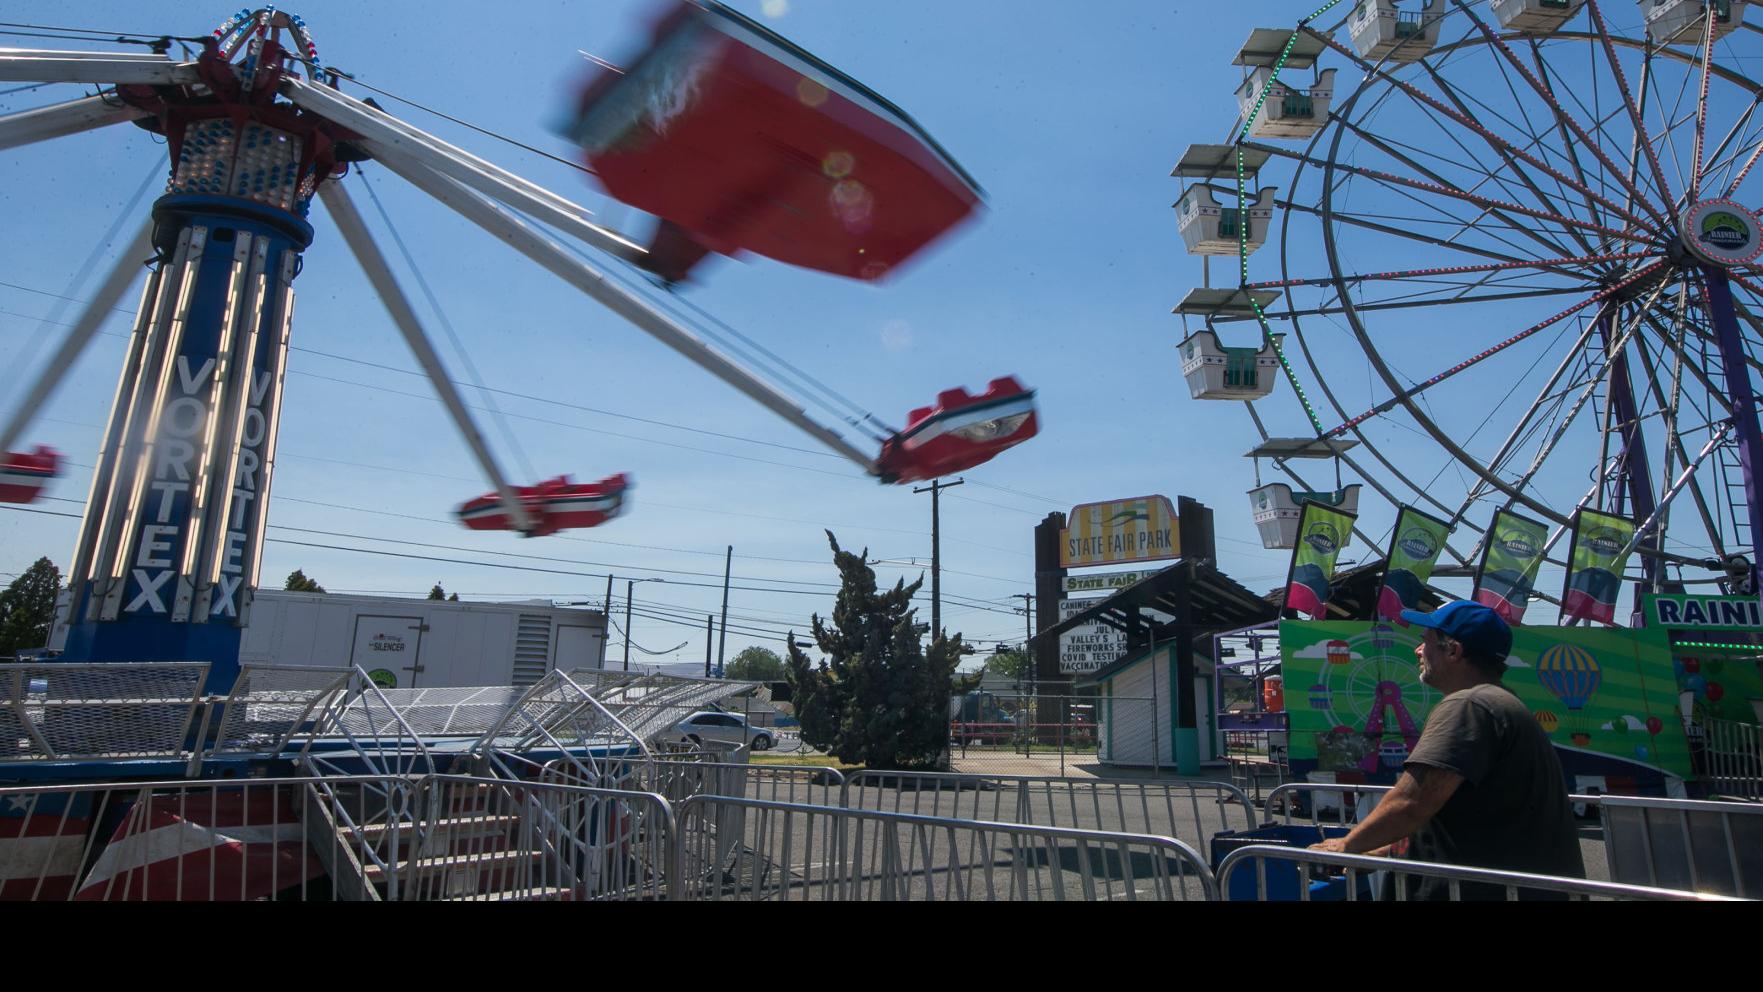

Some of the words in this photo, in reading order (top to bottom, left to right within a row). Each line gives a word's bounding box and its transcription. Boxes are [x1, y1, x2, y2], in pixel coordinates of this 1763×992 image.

[124, 355, 216, 614] VORTEX
[210, 368, 271, 617] VORTEX
[1069, 536, 1104, 557] STATE
[1108, 533, 1135, 553] FAIR
[1140, 528, 1172, 549] PARK
[1067, 578, 1104, 590] STATE
[374, 642, 405, 652] SILENCER
[1067, 643, 1115, 653] FIREWORKS
[1061, 653, 1087, 662] COVID
